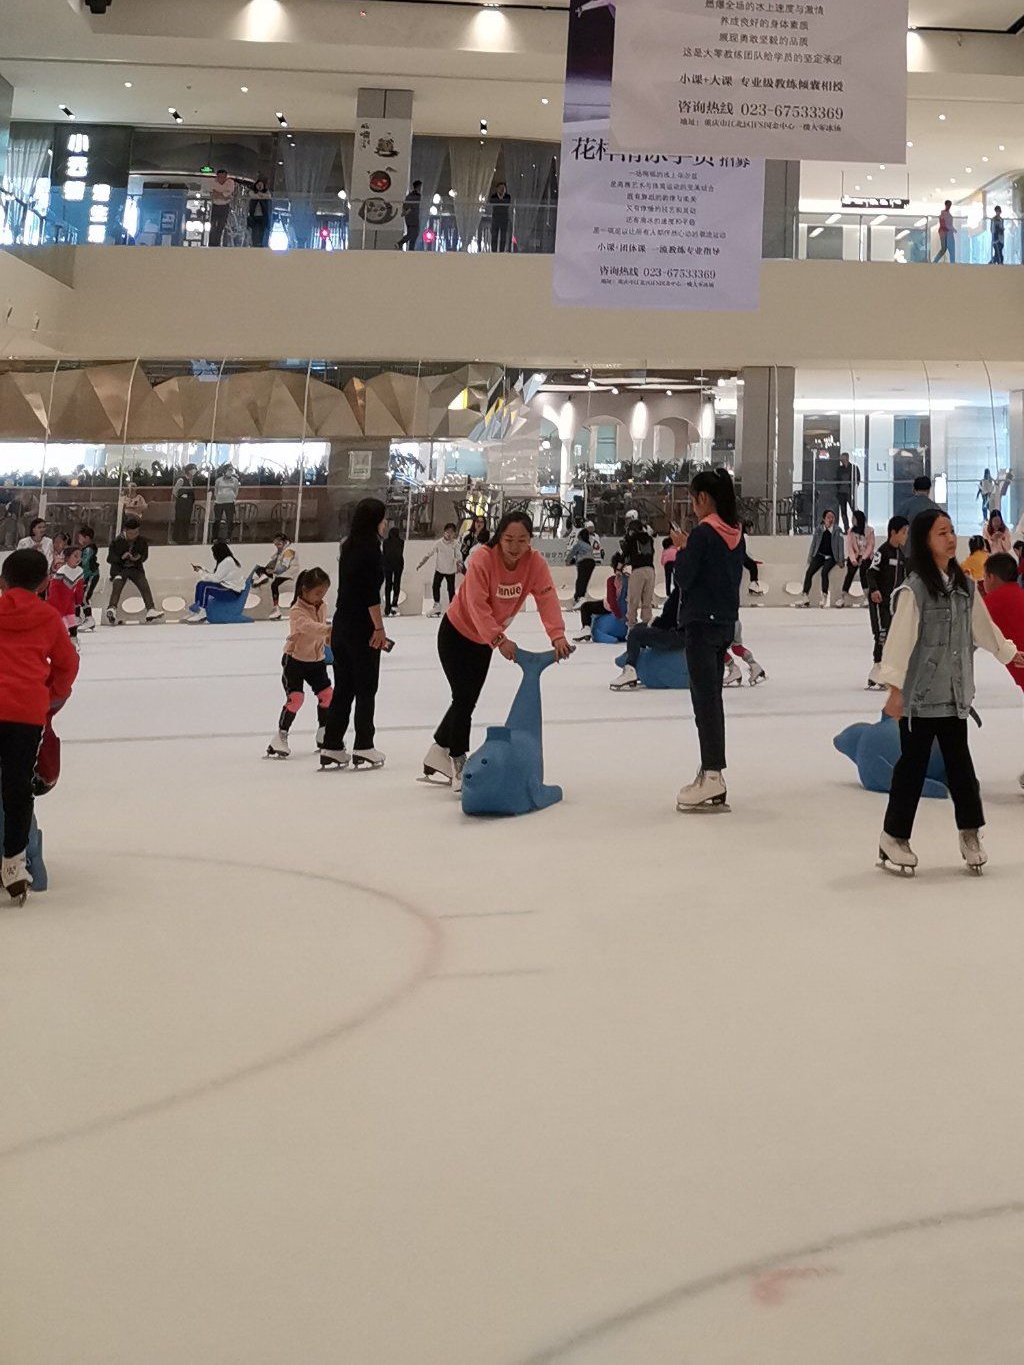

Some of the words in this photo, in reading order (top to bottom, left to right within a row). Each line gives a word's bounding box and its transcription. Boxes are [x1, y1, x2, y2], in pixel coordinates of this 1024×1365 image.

[678, 100, 734, 115] 咨询热线
[740, 102, 844, 120] 023-67533369
